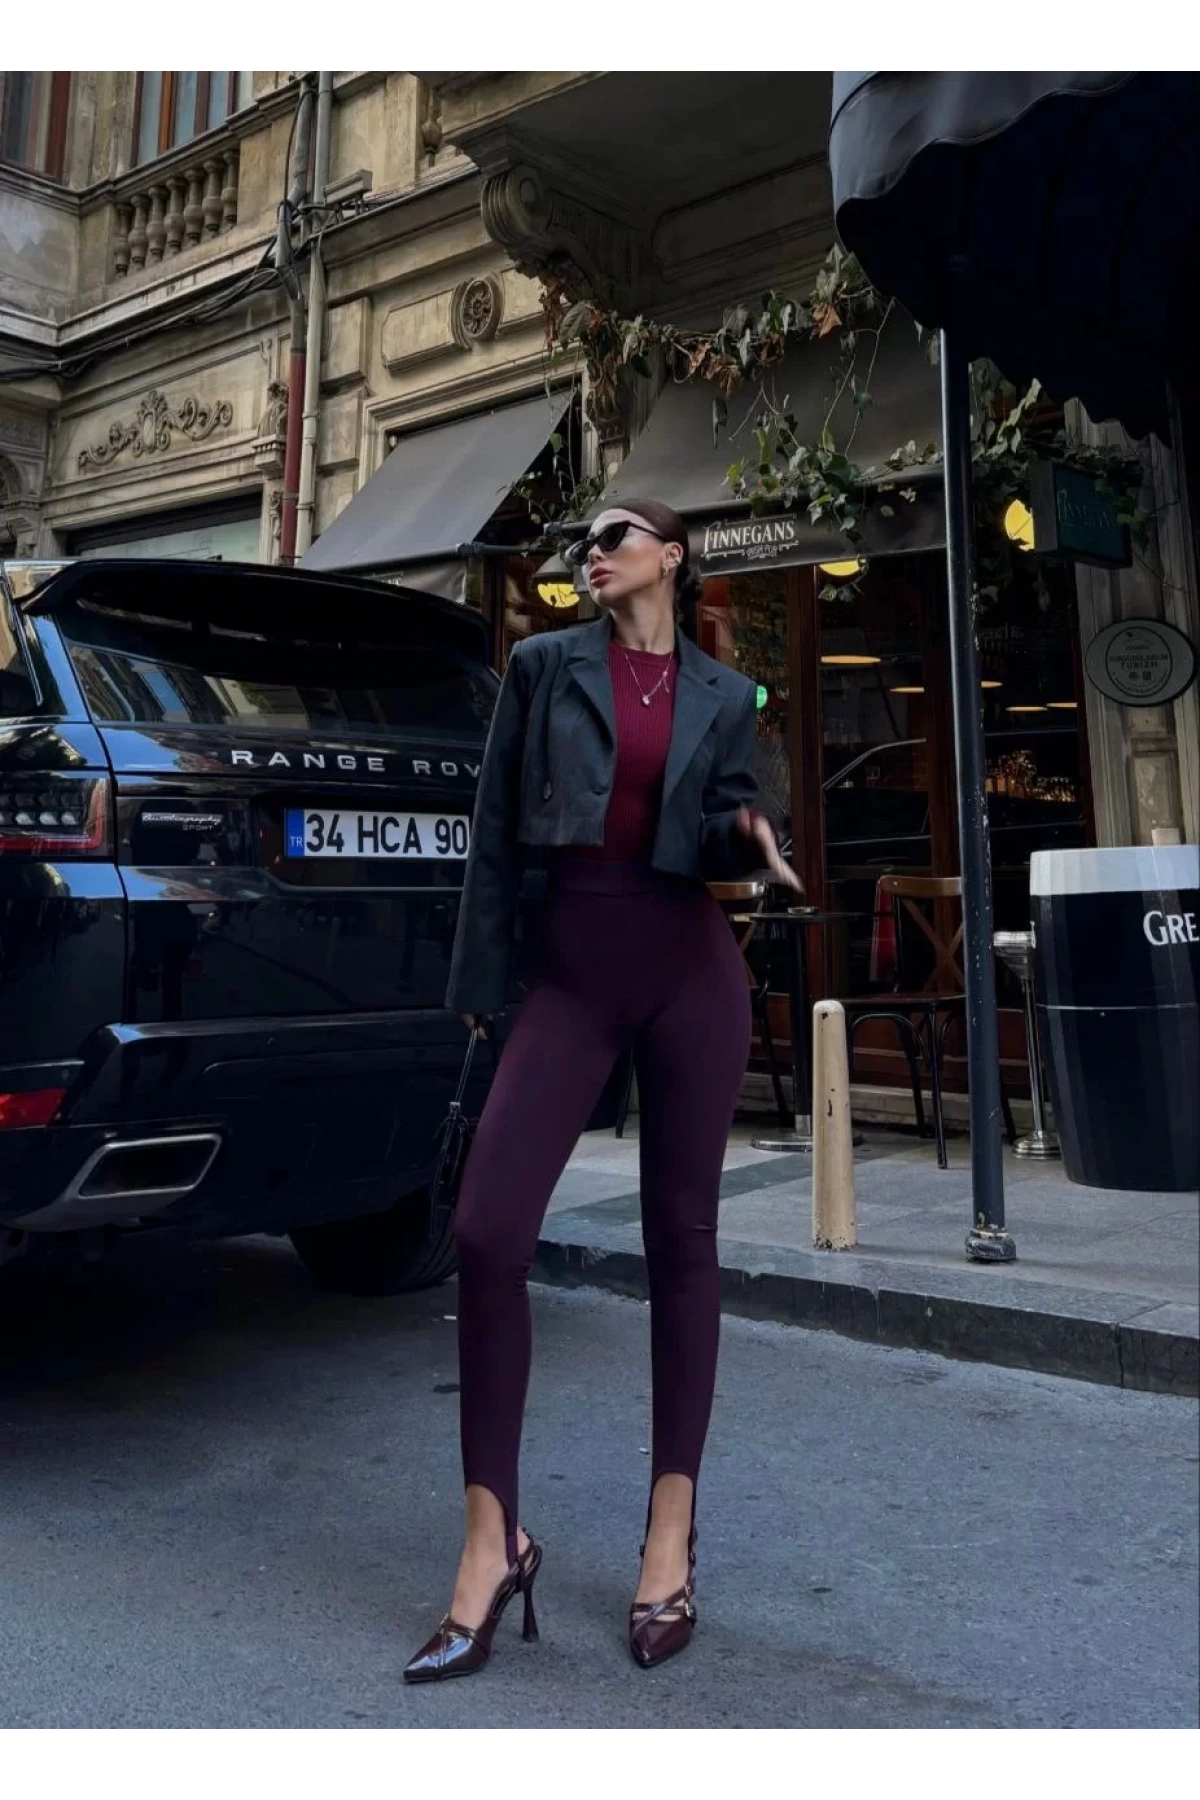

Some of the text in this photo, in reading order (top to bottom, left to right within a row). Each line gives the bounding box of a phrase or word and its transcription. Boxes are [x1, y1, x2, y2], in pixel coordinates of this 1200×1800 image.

[703, 520, 795, 555] FINNEGANS
[231, 749, 386, 772] RANGE
[289, 836, 303, 848] TR
[306, 814, 468, 855] 34 HCA 90
[1143, 909, 1200, 946] GRE
